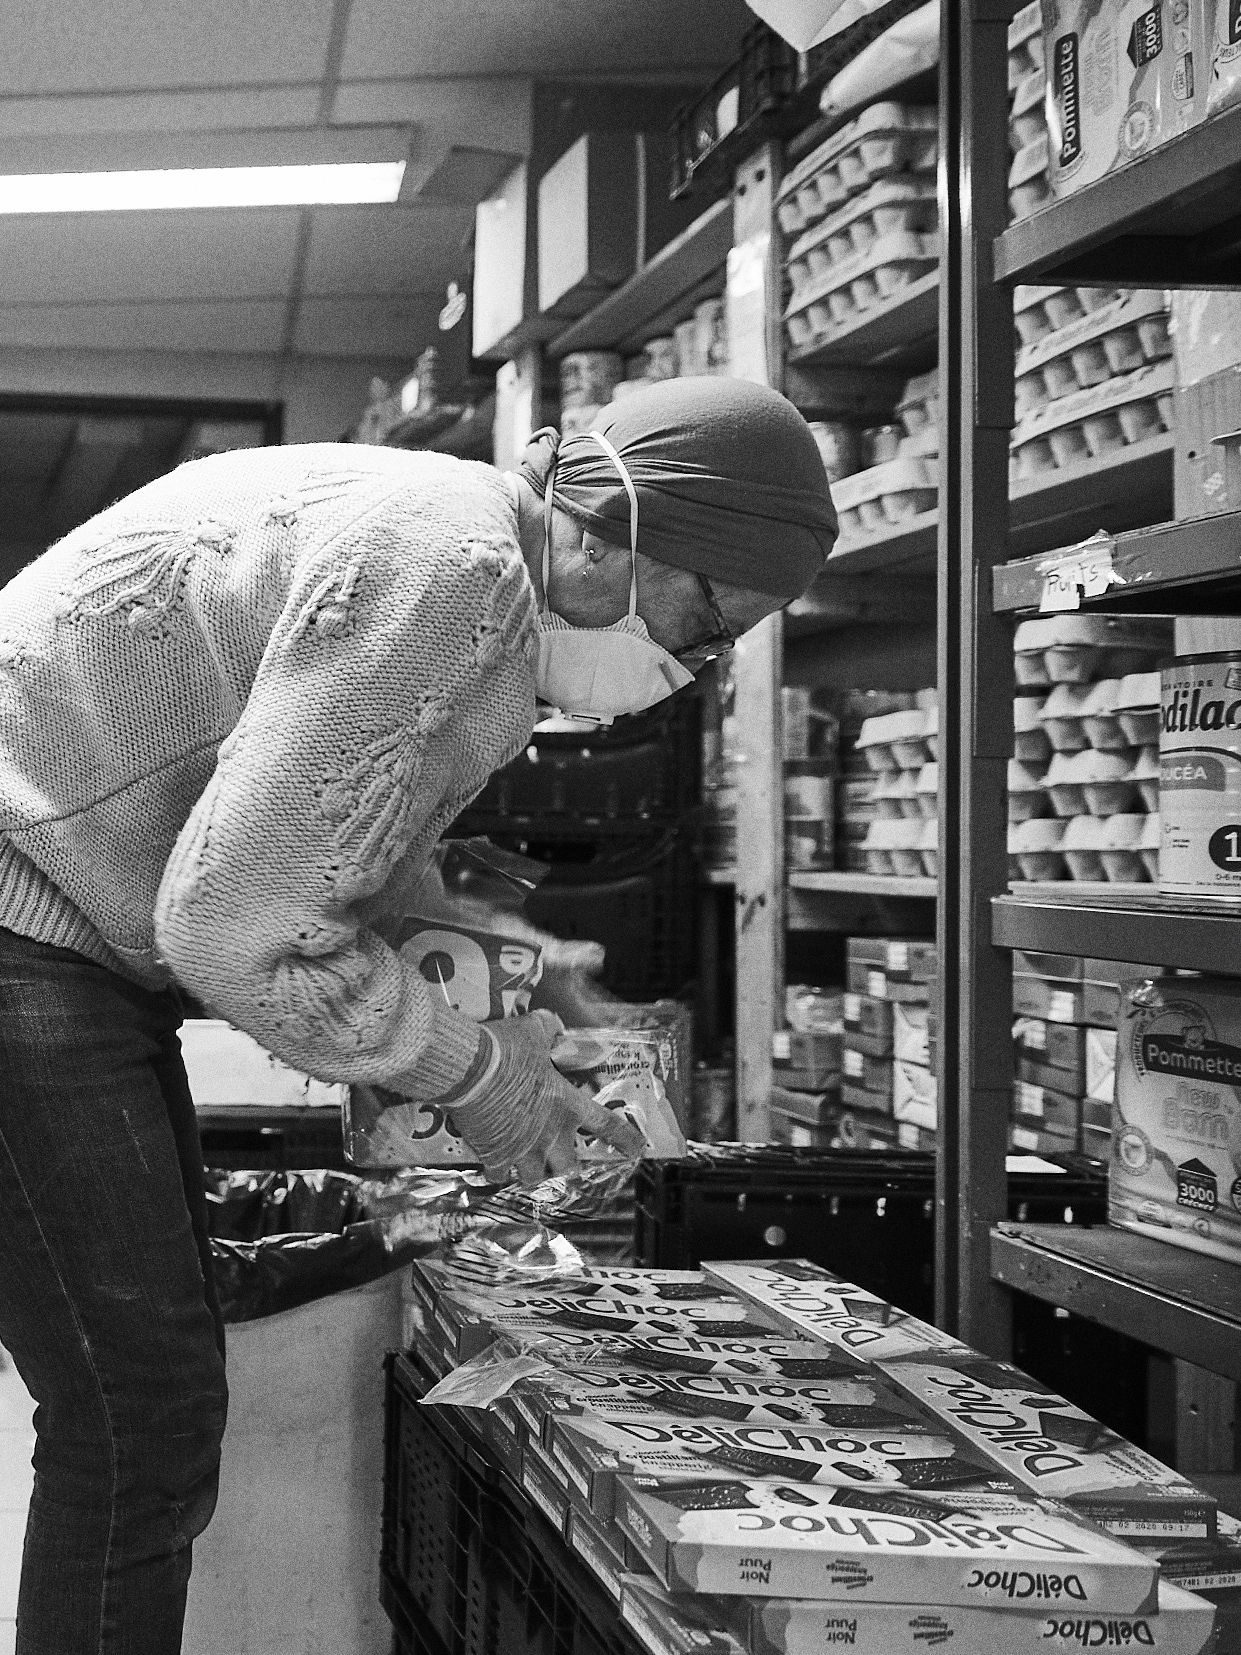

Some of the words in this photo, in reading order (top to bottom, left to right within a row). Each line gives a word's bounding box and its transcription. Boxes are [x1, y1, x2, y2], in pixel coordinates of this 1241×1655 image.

[1145, 12, 1158, 58] 3000
[1061, 40, 1077, 158] Pommette
[1147, 1044, 1241, 1077] Pommette
[1179, 1183, 1215, 1203] 3000
[748, 1274, 886, 1348] DéliChoc
[537, 1331, 789, 1357] DéliChoc
[559, 1369, 832, 1401] DéliChoc
[603, 1421, 906, 1455] DéliChoc
[927, 1376, 1084, 1477] DéliChoc
[737, 1513, 1091, 1554] DéliChoc
[738, 1558, 772, 1571] Puur
[740, 1571, 770, 1584] Noir
[967, 1569, 1088, 1600] DéliChoc
[825, 1618, 857, 1631] Puur
[826, 1631, 856, 1644] Noir
[1042, 1619, 1155, 1647] DéliChoc
